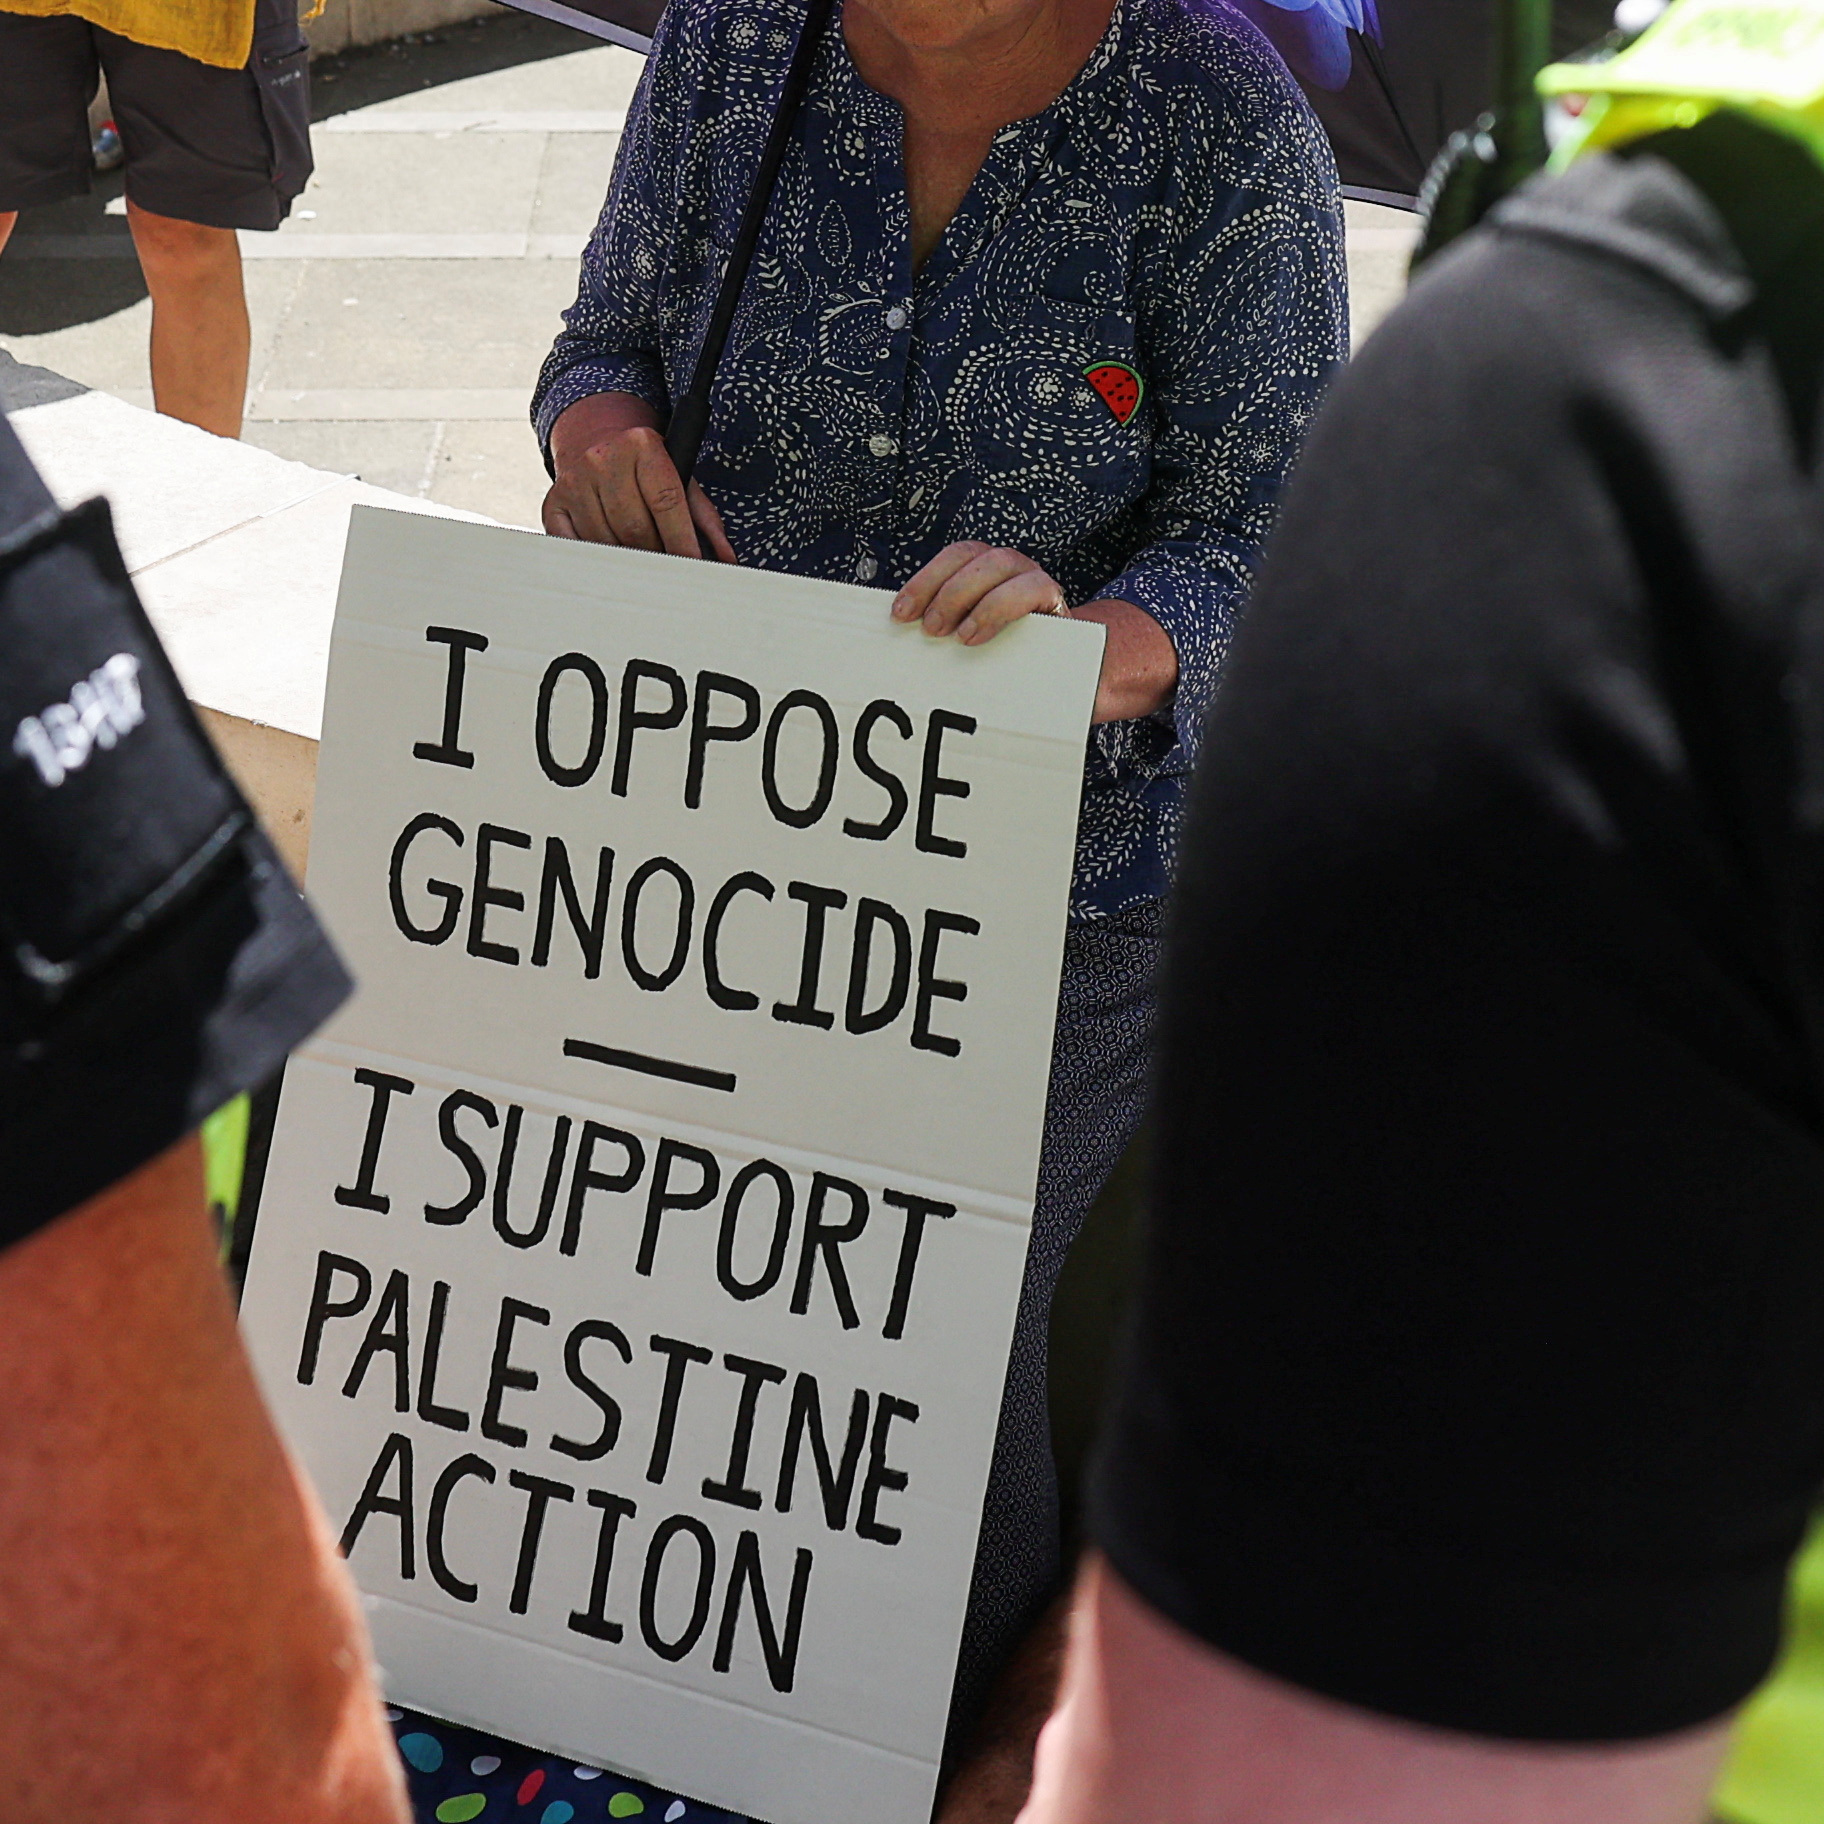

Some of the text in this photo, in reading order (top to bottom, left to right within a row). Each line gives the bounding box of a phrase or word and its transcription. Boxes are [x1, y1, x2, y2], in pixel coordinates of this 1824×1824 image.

[412, 625, 978, 859] I OPPOSE
[388, 812, 981, 1058] GENOCIDE
[333, 1067, 958, 1341] I SUPPORT
[296, 1249, 920, 1546] PALESTINE
[339, 1432, 814, 1694] ACTION
